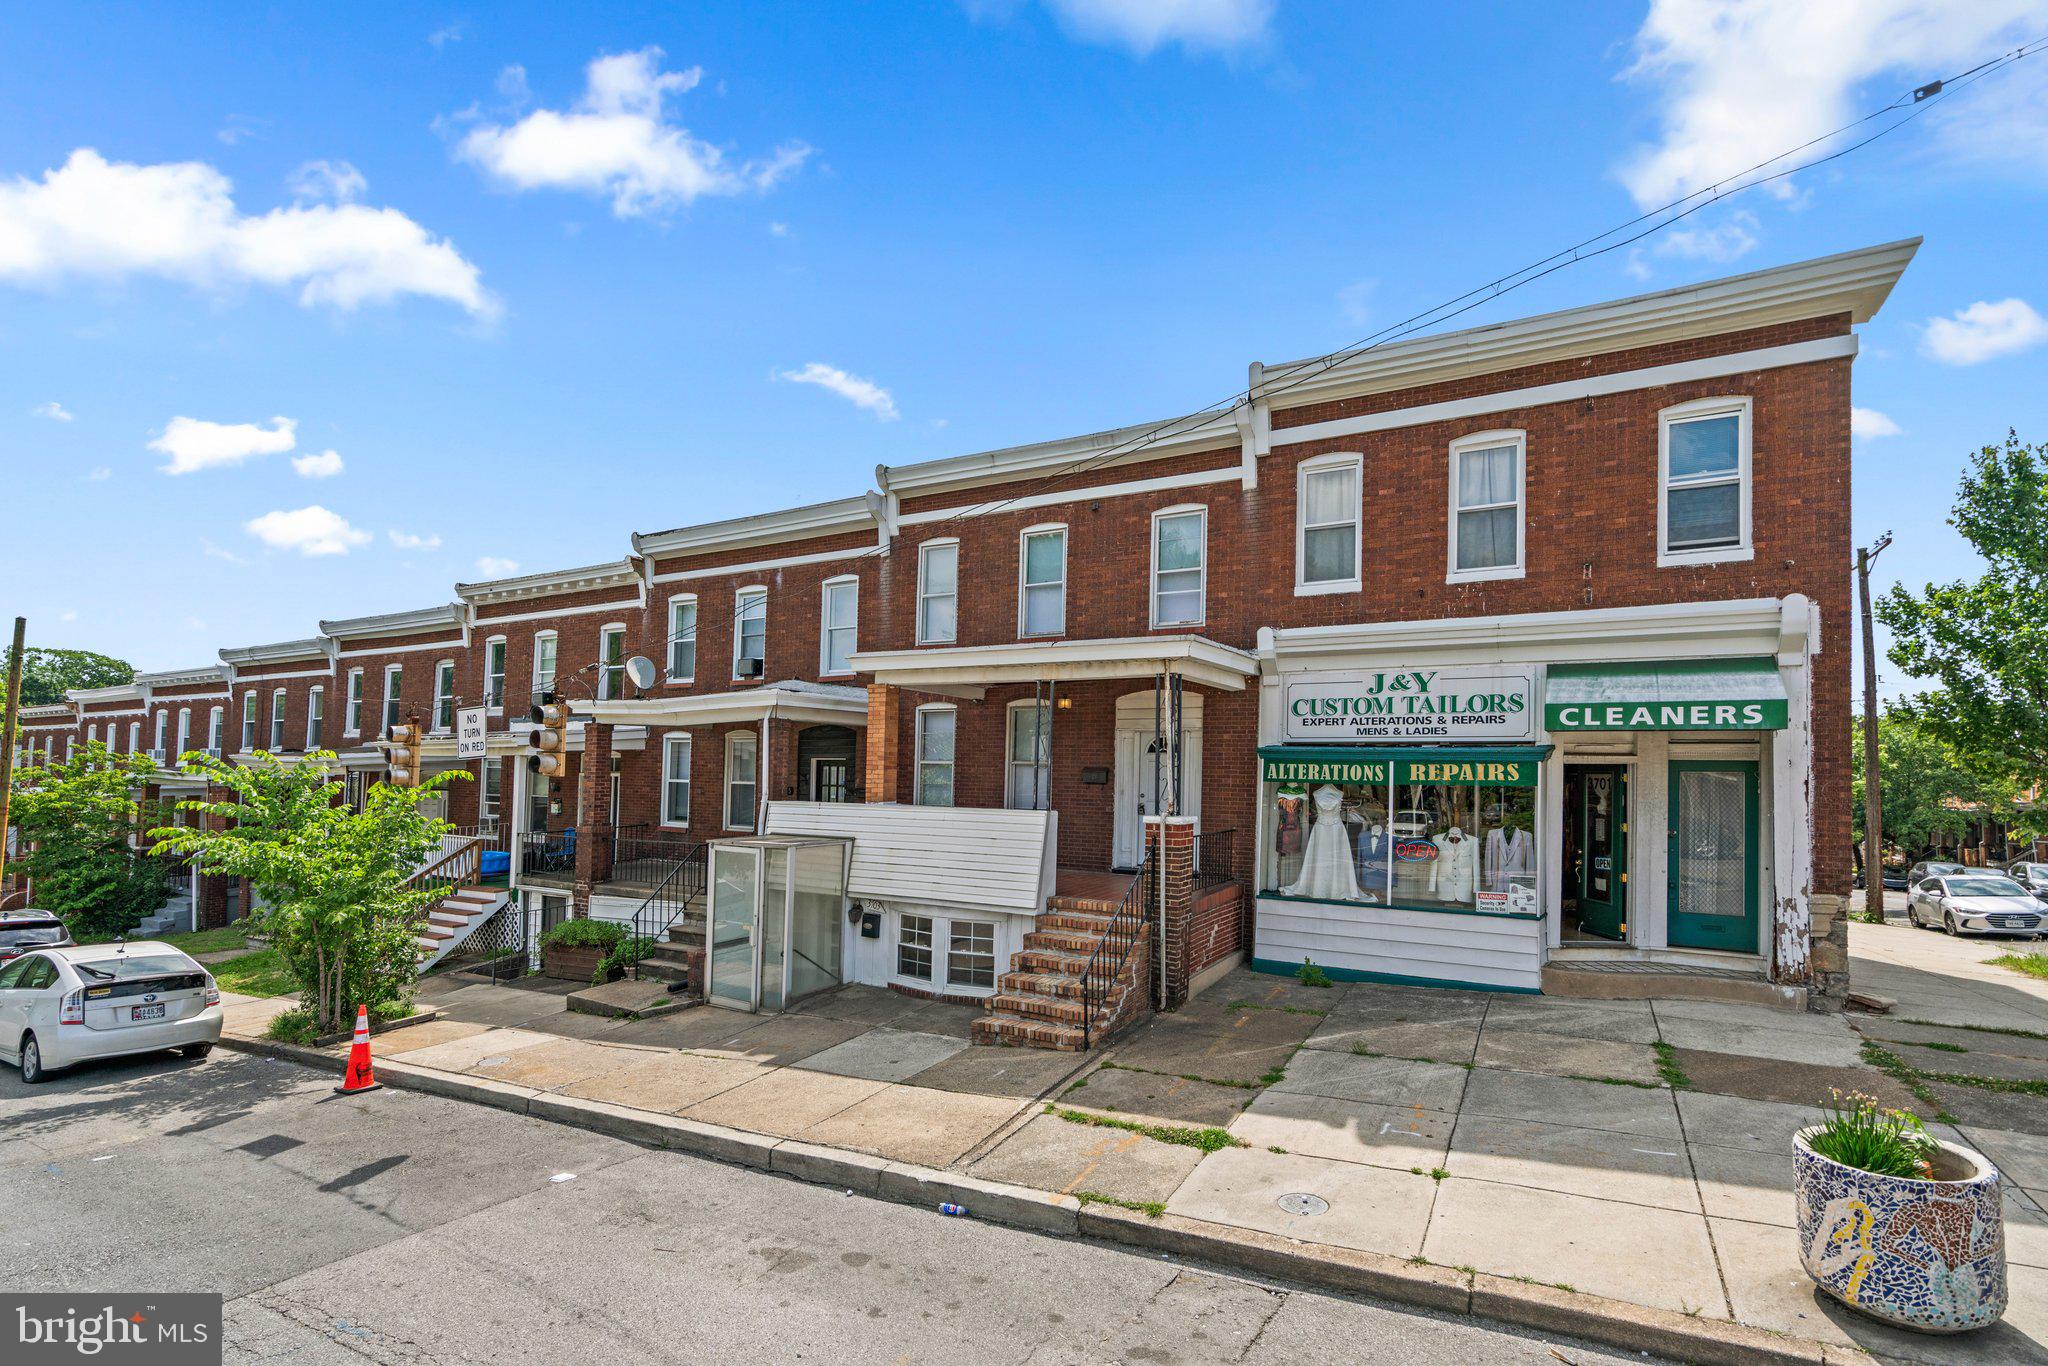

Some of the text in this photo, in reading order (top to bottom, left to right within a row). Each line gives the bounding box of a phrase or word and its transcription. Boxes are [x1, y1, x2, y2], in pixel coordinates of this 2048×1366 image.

[1367, 671, 1438, 694] J&Y
[1291, 693, 1525, 717] CUSTOM TAILORS
[466, 714, 478, 724] NO
[1302, 715, 1506, 727] EXPERT ALTERATIONS & REPAIRS
[1559, 705, 1763, 726] CLEANERS
[463, 728, 480, 738] TURN
[1356, 727, 1448, 736] MENS & LADIES
[460, 741, 484, 752] ON RED
[1267, 763, 1384, 781] ALTERATIONS
[1409, 763, 1520, 781] REPAIRS
[1396, 843, 1437, 858] OPEN
[1595, 858, 1611, 869] OPEN
